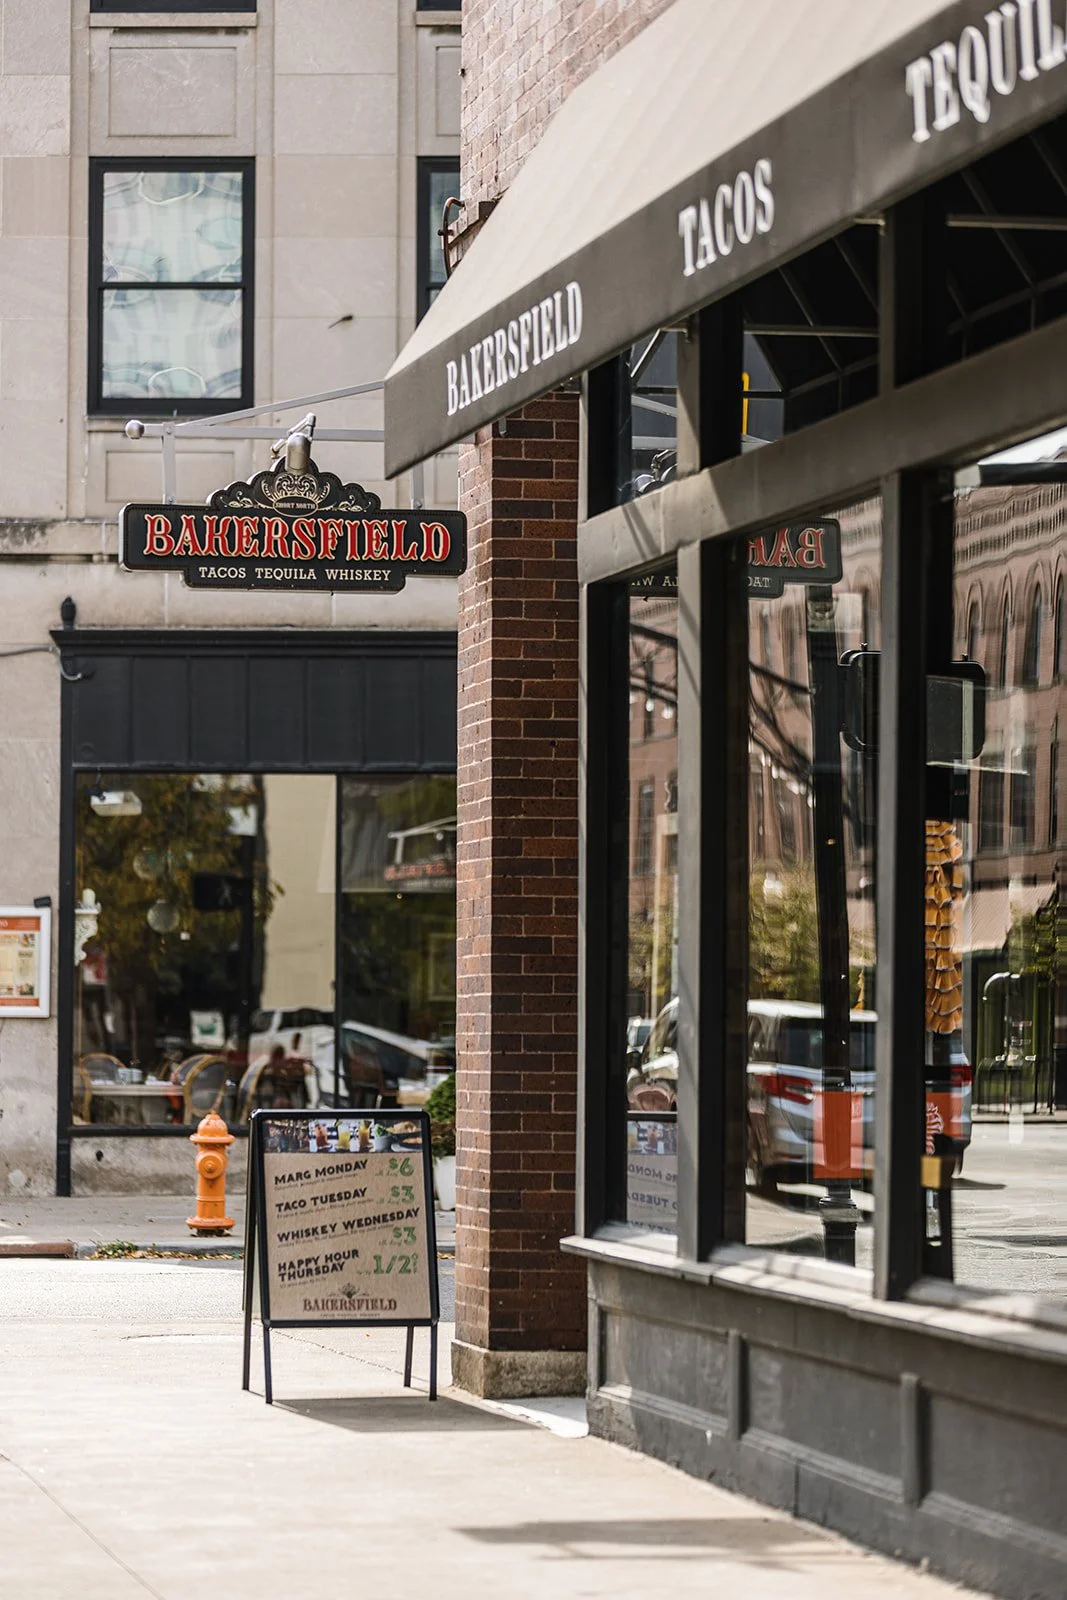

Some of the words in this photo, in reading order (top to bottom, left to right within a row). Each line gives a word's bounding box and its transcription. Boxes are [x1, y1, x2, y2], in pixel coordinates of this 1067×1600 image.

[905, 0, 1067, 143] TEQUIL
[678, 158, 774, 277] TACOS
[446, 281, 583, 416] BAKERSFIELD
[143, 514, 451, 562] BAKERSFIELD
[199, 566, 246, 580] TACOS
[255, 567, 317, 581] TEQUILA
[325, 568, 392, 582] WHISKEY
[274, 1170, 312, 1185] MARG
[315, 1159, 369, 1178] MONDAY
[389, 1157, 415, 1177] $6
[275, 1199, 306, 1213] TACO
[311, 1187, 368, 1206] TUESDAY
[391, 1185, 415, 1204] $3
[277, 1222, 337, 1242] WHISKEY
[342, 1207, 420, 1231] WEDNESDAY
[392, 1226, 417, 1246] $3
[278, 1255, 320, 1272] HAPPY
[325, 1249, 360, 1263] HOUR
[278, 1262, 346, 1282] THURSDAY
[302, 1298, 397, 1313] BAKERSFIELD
